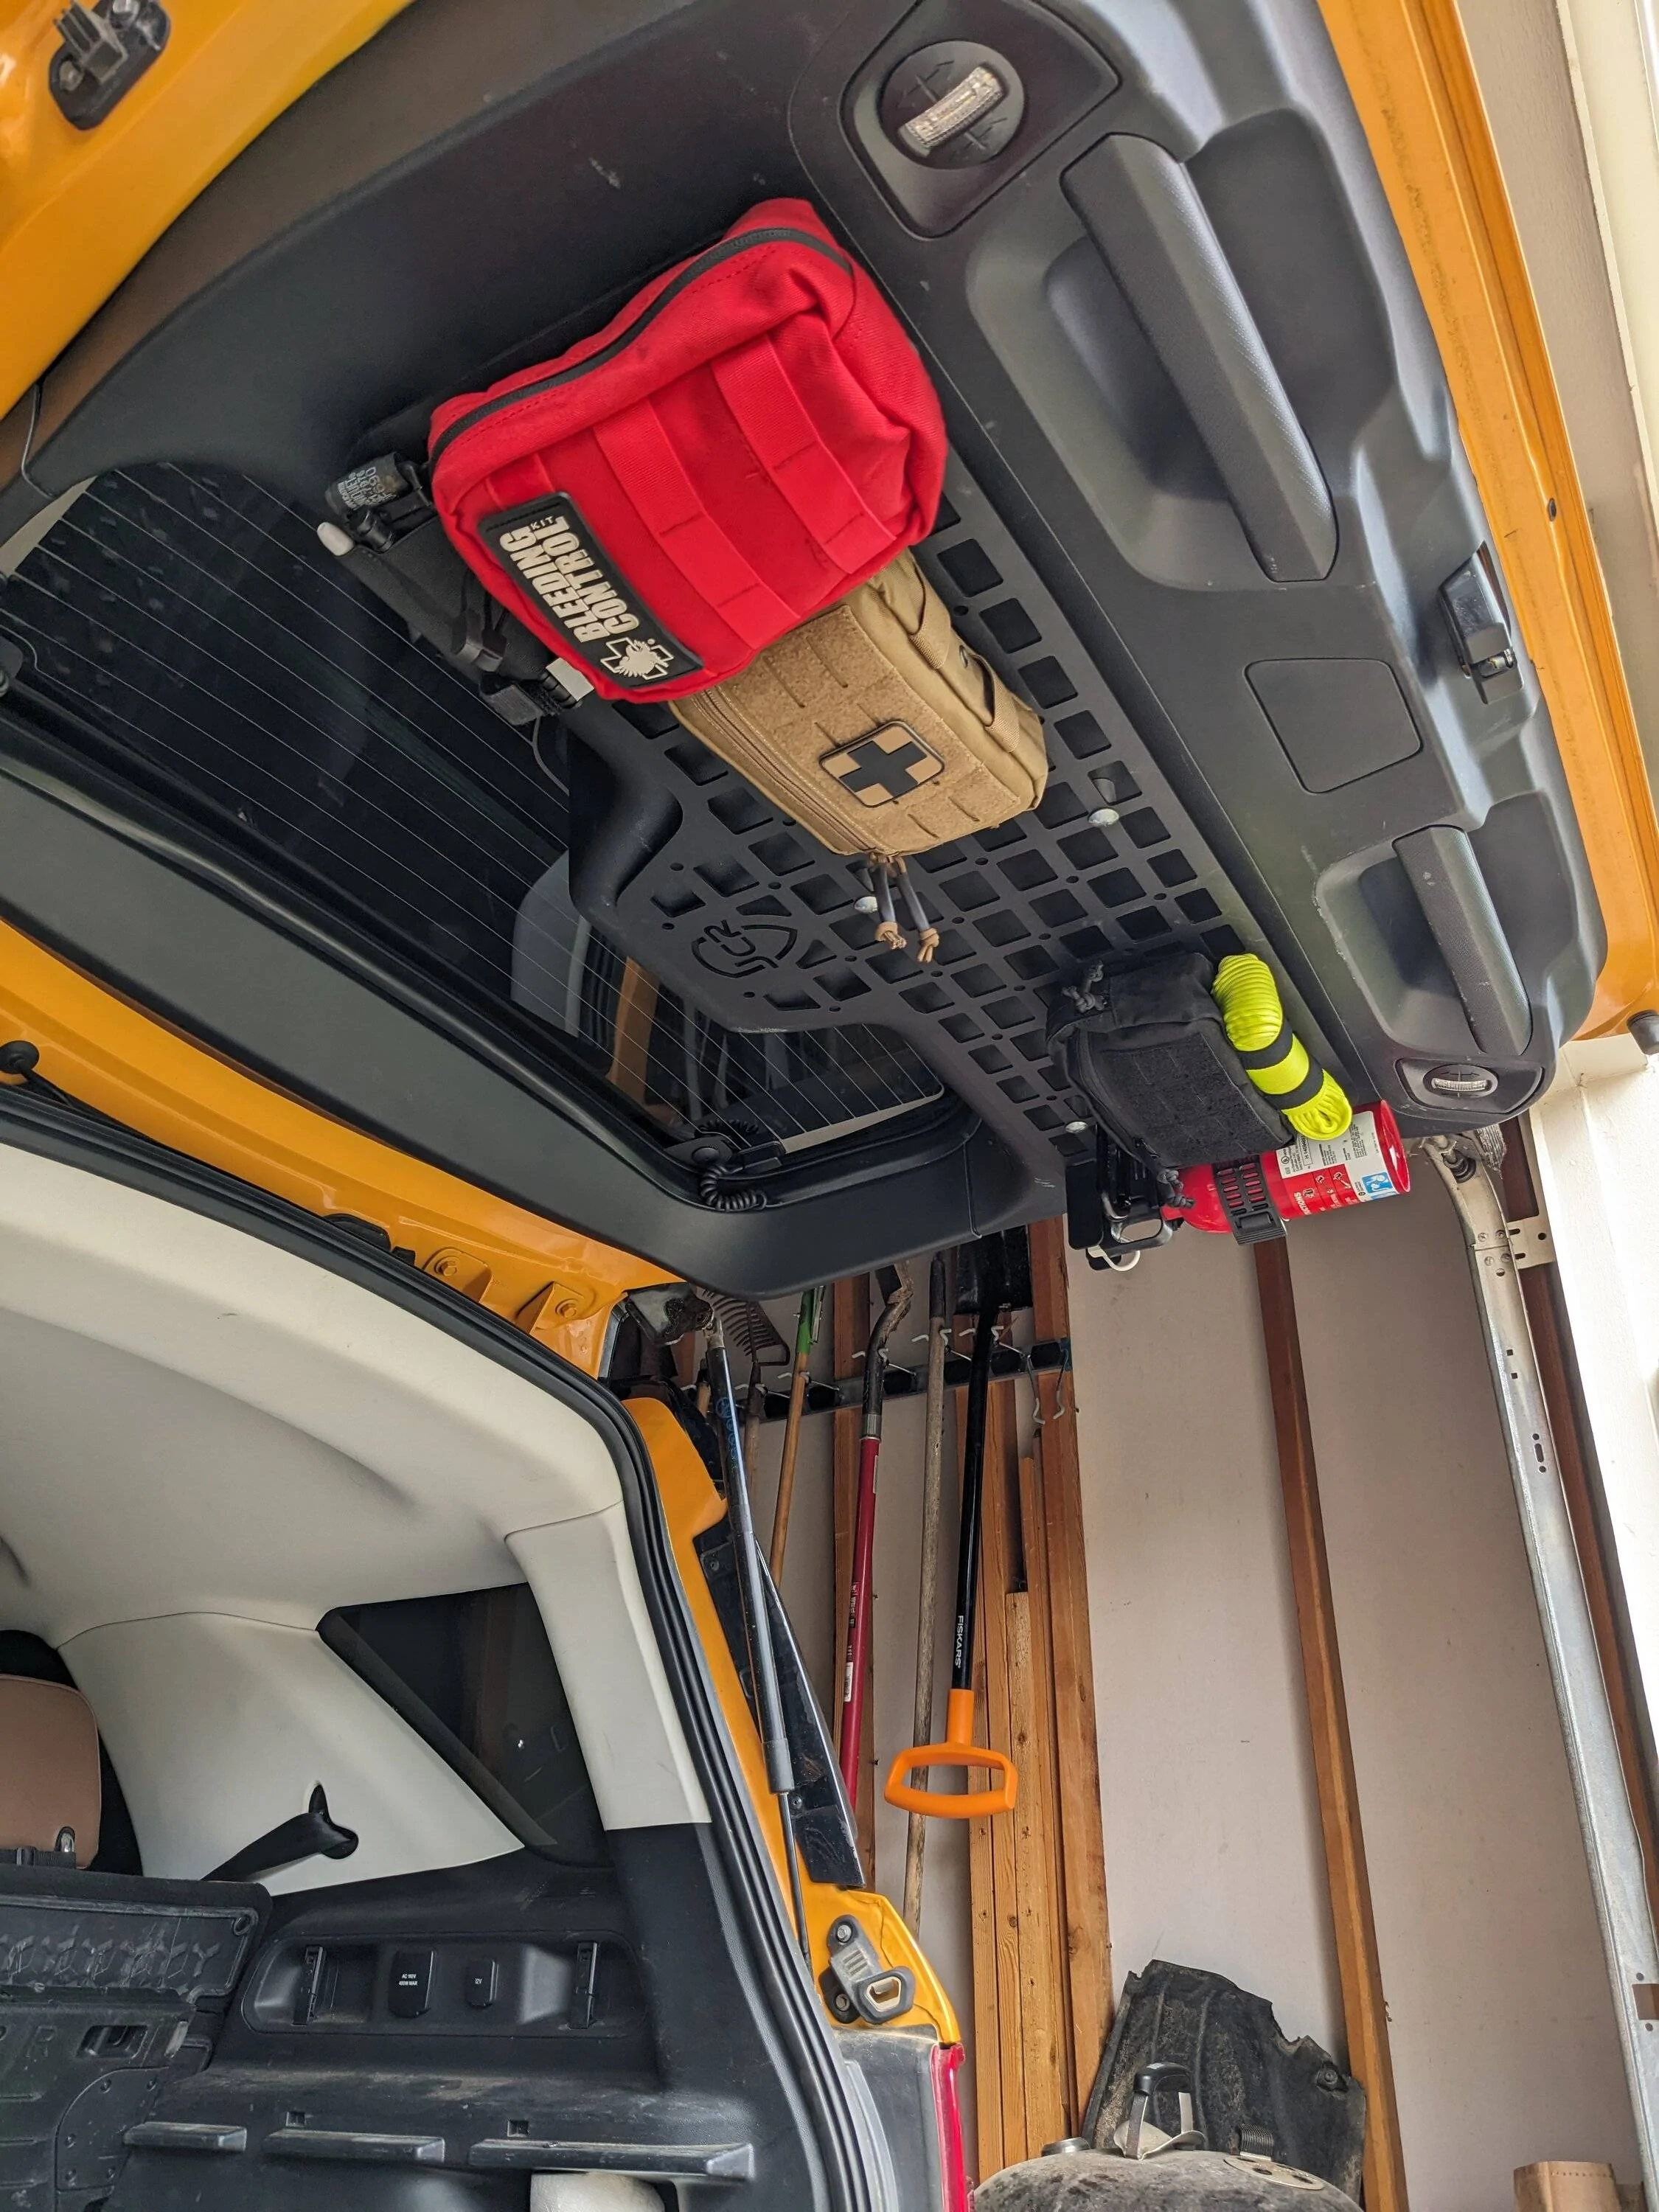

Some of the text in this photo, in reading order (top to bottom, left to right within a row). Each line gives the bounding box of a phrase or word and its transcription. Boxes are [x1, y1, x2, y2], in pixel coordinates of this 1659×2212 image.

[530, 516, 554, 531] KIT
[500, 526, 610, 643] BLEEDING
[535, 516, 640, 634] CONTROL
[955, 1615, 964, 1667] FISKARS
